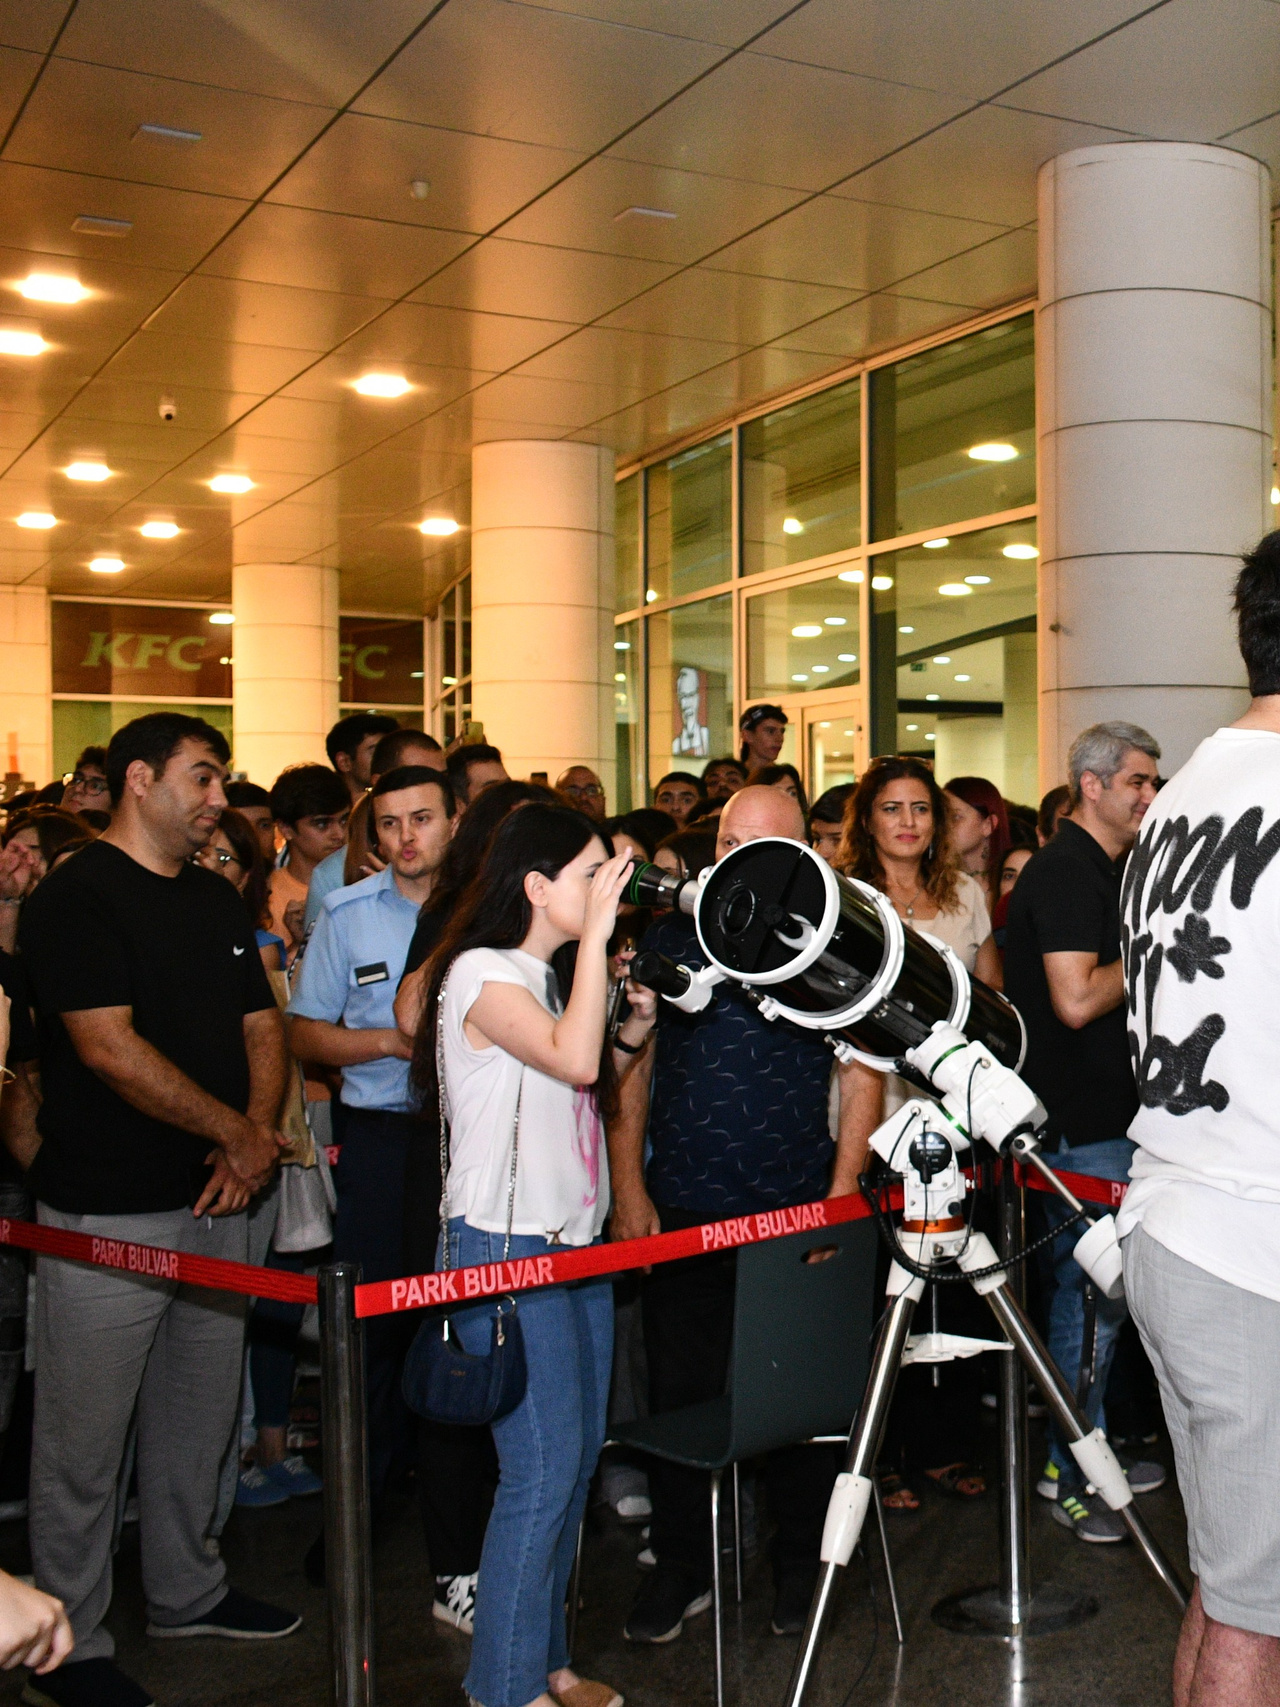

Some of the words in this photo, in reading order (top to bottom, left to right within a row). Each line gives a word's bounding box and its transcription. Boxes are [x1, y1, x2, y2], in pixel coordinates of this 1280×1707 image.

[80, 631, 207, 672] KFC
[701, 1216, 754, 1250] PARK
[755, 1201, 827, 1239] BULVAR
[92, 1238, 125, 1269] PARK
[128, 1244, 179, 1278] BULVAR
[391, 1271, 458, 1310] PARK
[463, 1256, 554, 1297] BULVAR
